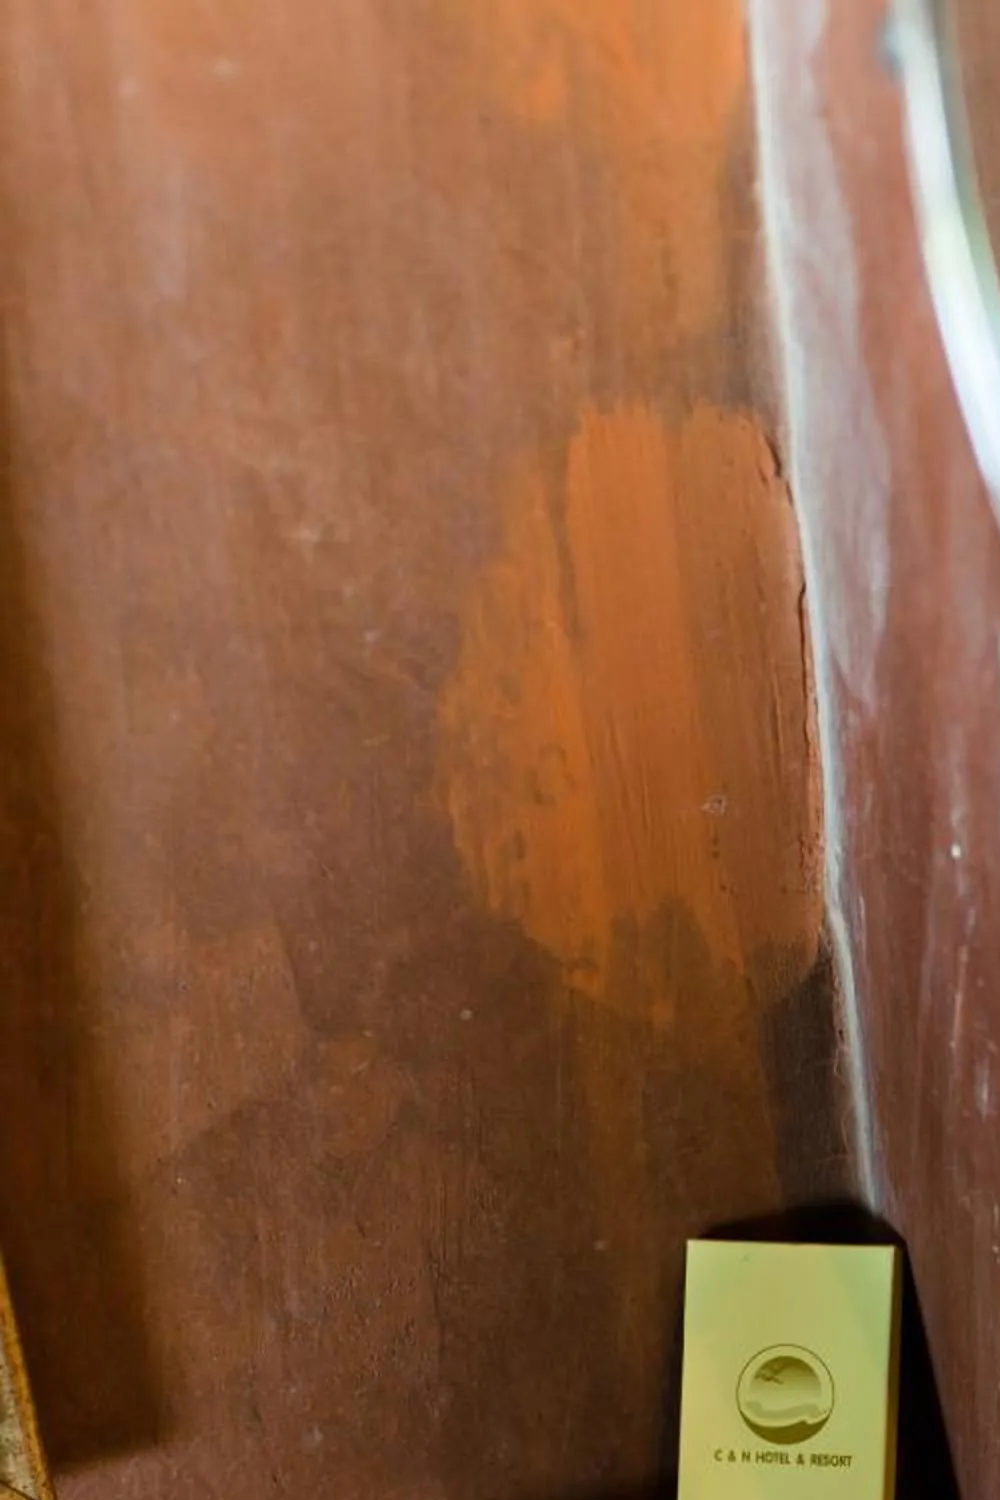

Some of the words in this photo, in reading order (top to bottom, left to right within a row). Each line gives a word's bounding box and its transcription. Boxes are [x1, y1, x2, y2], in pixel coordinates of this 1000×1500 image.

[714, 1448, 723, 1463] C
[727, 1449, 736, 1464] &
[741, 1450, 751, 1464] N
[755, 1450, 791, 1465] HOTEL
[796, 1453, 805, 1466] &
[810, 1453, 853, 1468] RESORT
